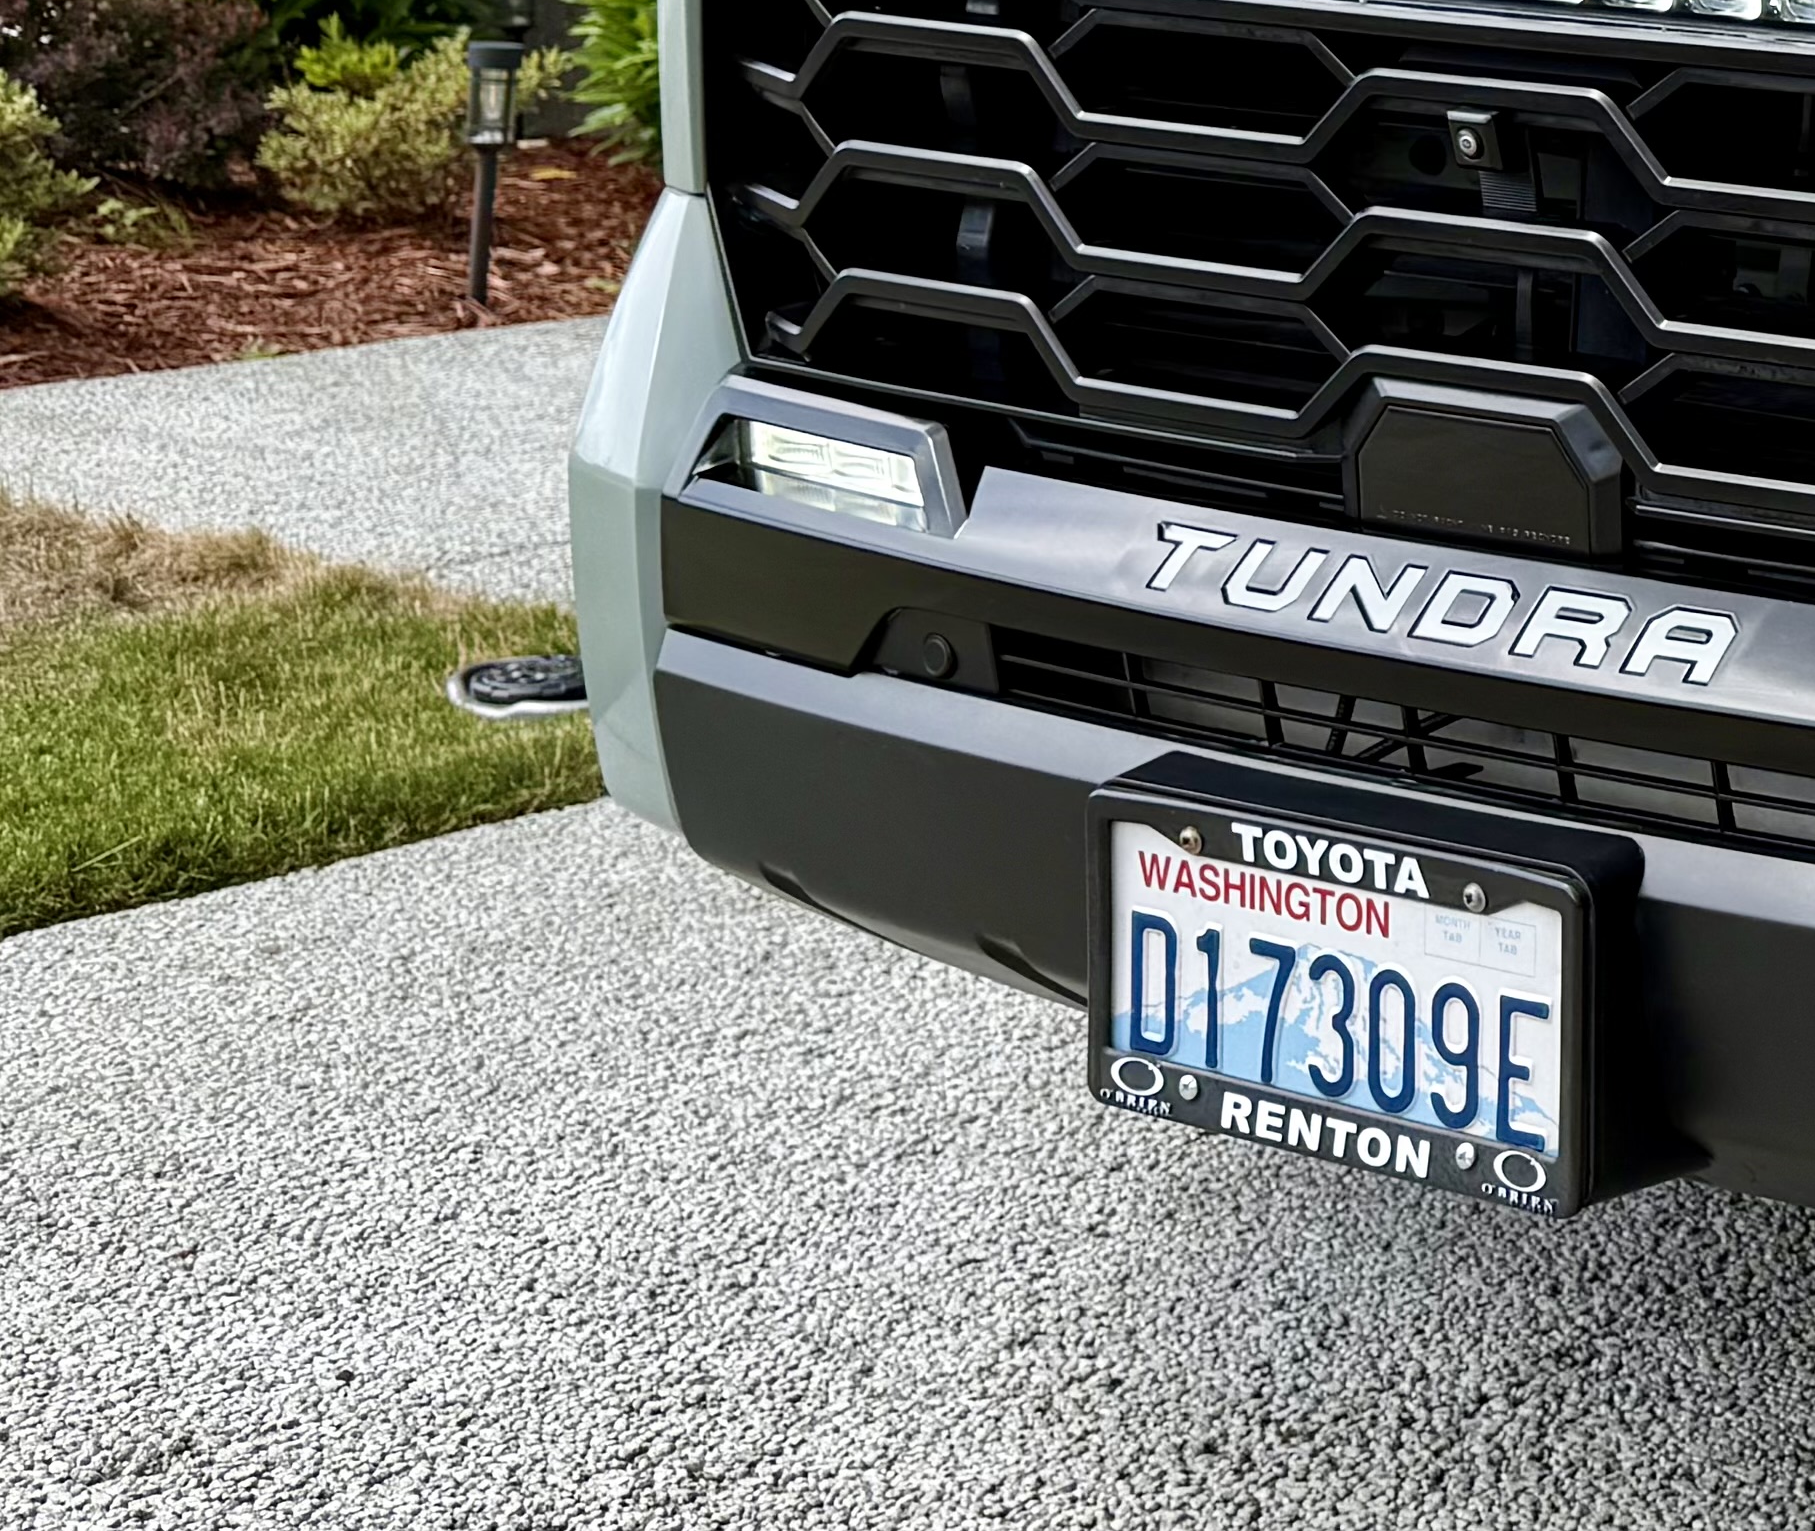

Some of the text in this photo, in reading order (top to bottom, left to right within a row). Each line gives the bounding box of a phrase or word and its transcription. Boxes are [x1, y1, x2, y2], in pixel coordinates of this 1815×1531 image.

[1146, 521, 1739, 686] TUNDRA
[1138, 850, 1391, 939] WASHINGTON
[1231, 822, 1430, 899] TOYOTA
[1435, 914, 1470, 929] MONTH
[1443, 930, 1463, 943] TAB
[1495, 927, 1521, 940] YEAR
[1498, 942, 1518, 955] TAB
[1129, 910, 1550, 1153] D17309E
[1220, 1091, 1431, 1179] RENTON
